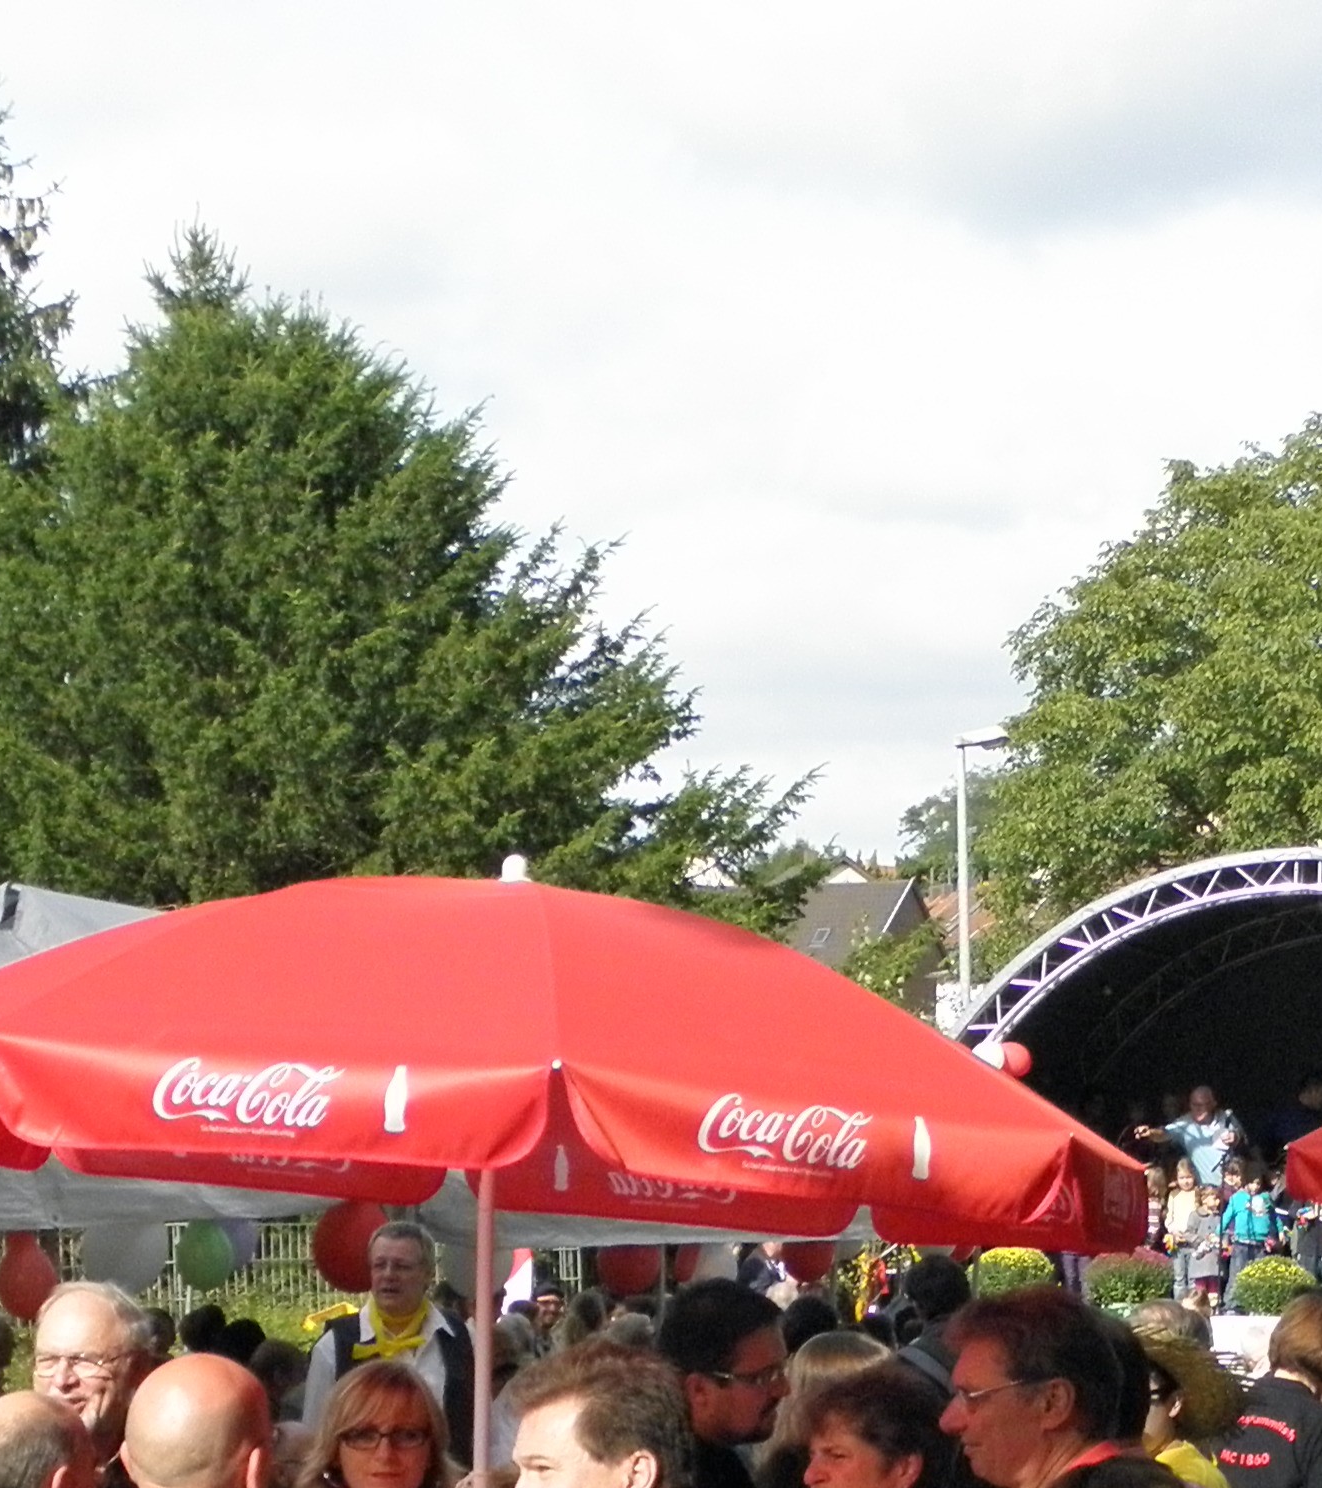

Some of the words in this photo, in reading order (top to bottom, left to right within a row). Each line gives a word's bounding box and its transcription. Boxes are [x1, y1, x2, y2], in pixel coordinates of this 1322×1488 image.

[152, 1056, 347, 1128] Coca-Cola
[697, 1092, 874, 1170] Coca-Cola
[1239, 1452, 1271, 1468] 1860
